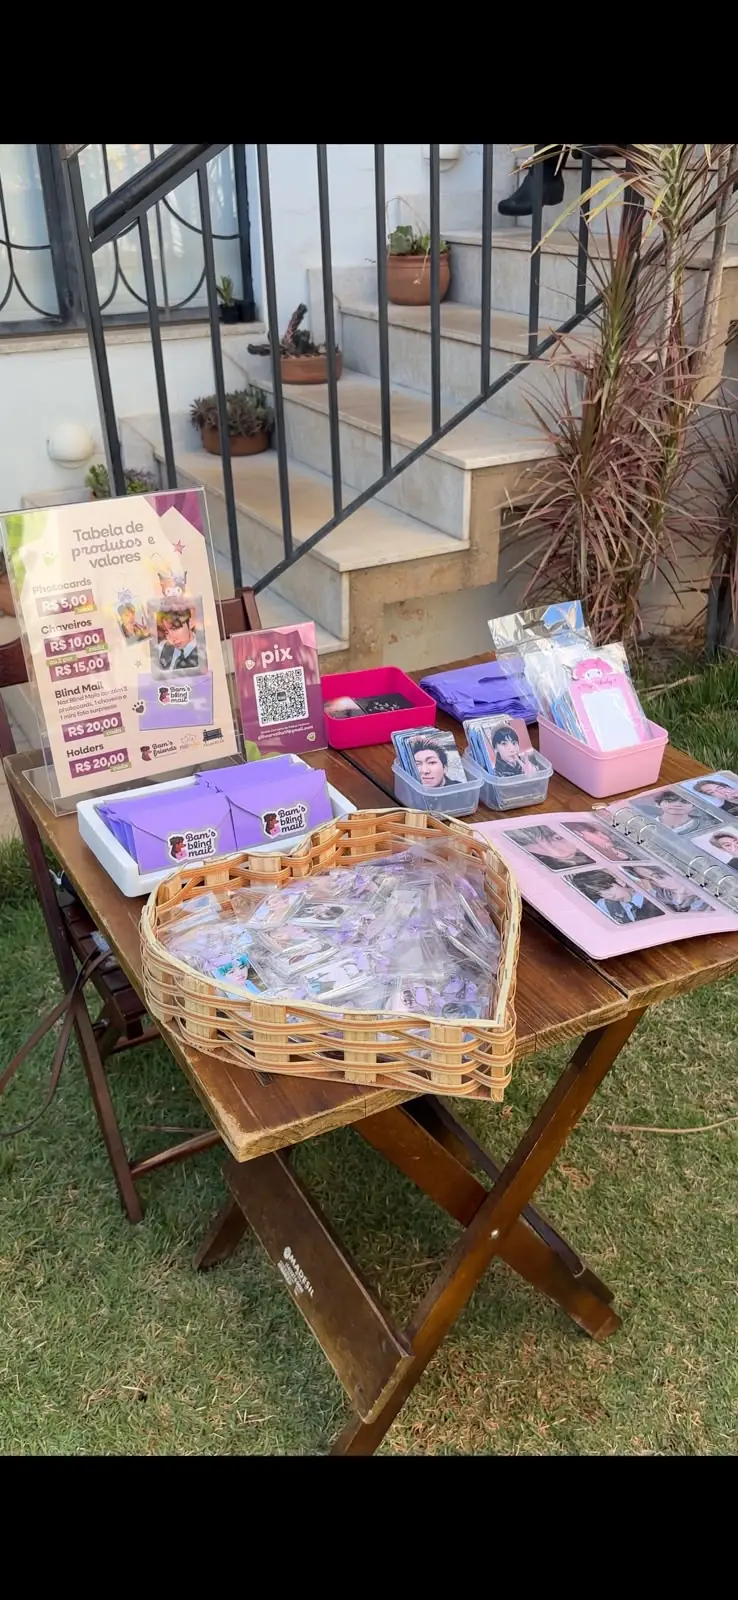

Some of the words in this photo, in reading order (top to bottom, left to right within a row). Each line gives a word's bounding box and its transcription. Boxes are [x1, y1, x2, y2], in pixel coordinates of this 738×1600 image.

[72, 524, 123, 542] Tabela
[126, 520, 144, 534] de
[71, 538, 142, 562] produtos
[148, 536, 156, 544] e
[89, 552, 141, 568] valores
[32, 577, 92, 594] Photocards
[42, 600, 59, 612] R$
[61, 594, 87, 610] 5,00
[41, 619, 92, 634] Chaveiros
[50, 640, 66, 652] R$
[68, 634, 100, 648] 10,00
[260, 644, 293, 668] pix
[55, 664, 72, 677] R$
[73, 658, 104, 673] 15,00
[54, 686, 80, 698] Blind
[82, 681, 104, 693] Mail
[68, 724, 84, 738] R$
[86, 718, 118, 732] 20,00
[66, 744, 104, 758] Holders
[152, 740, 173, 750] Bam's
[153, 746, 177, 758] friends
[75, 761, 92, 774] R$
[92, 752, 124, 768] 20,00
[278, 804, 306, 818] Bam's
[280, 814, 303, 826] blind
[281, 821, 304, 833] mail
[185, 829, 216, 842] Bam's
[187, 838, 212, 850] blind
[188, 846, 214, 857] mail
[289, 1254, 314, 1297] MADESIL
